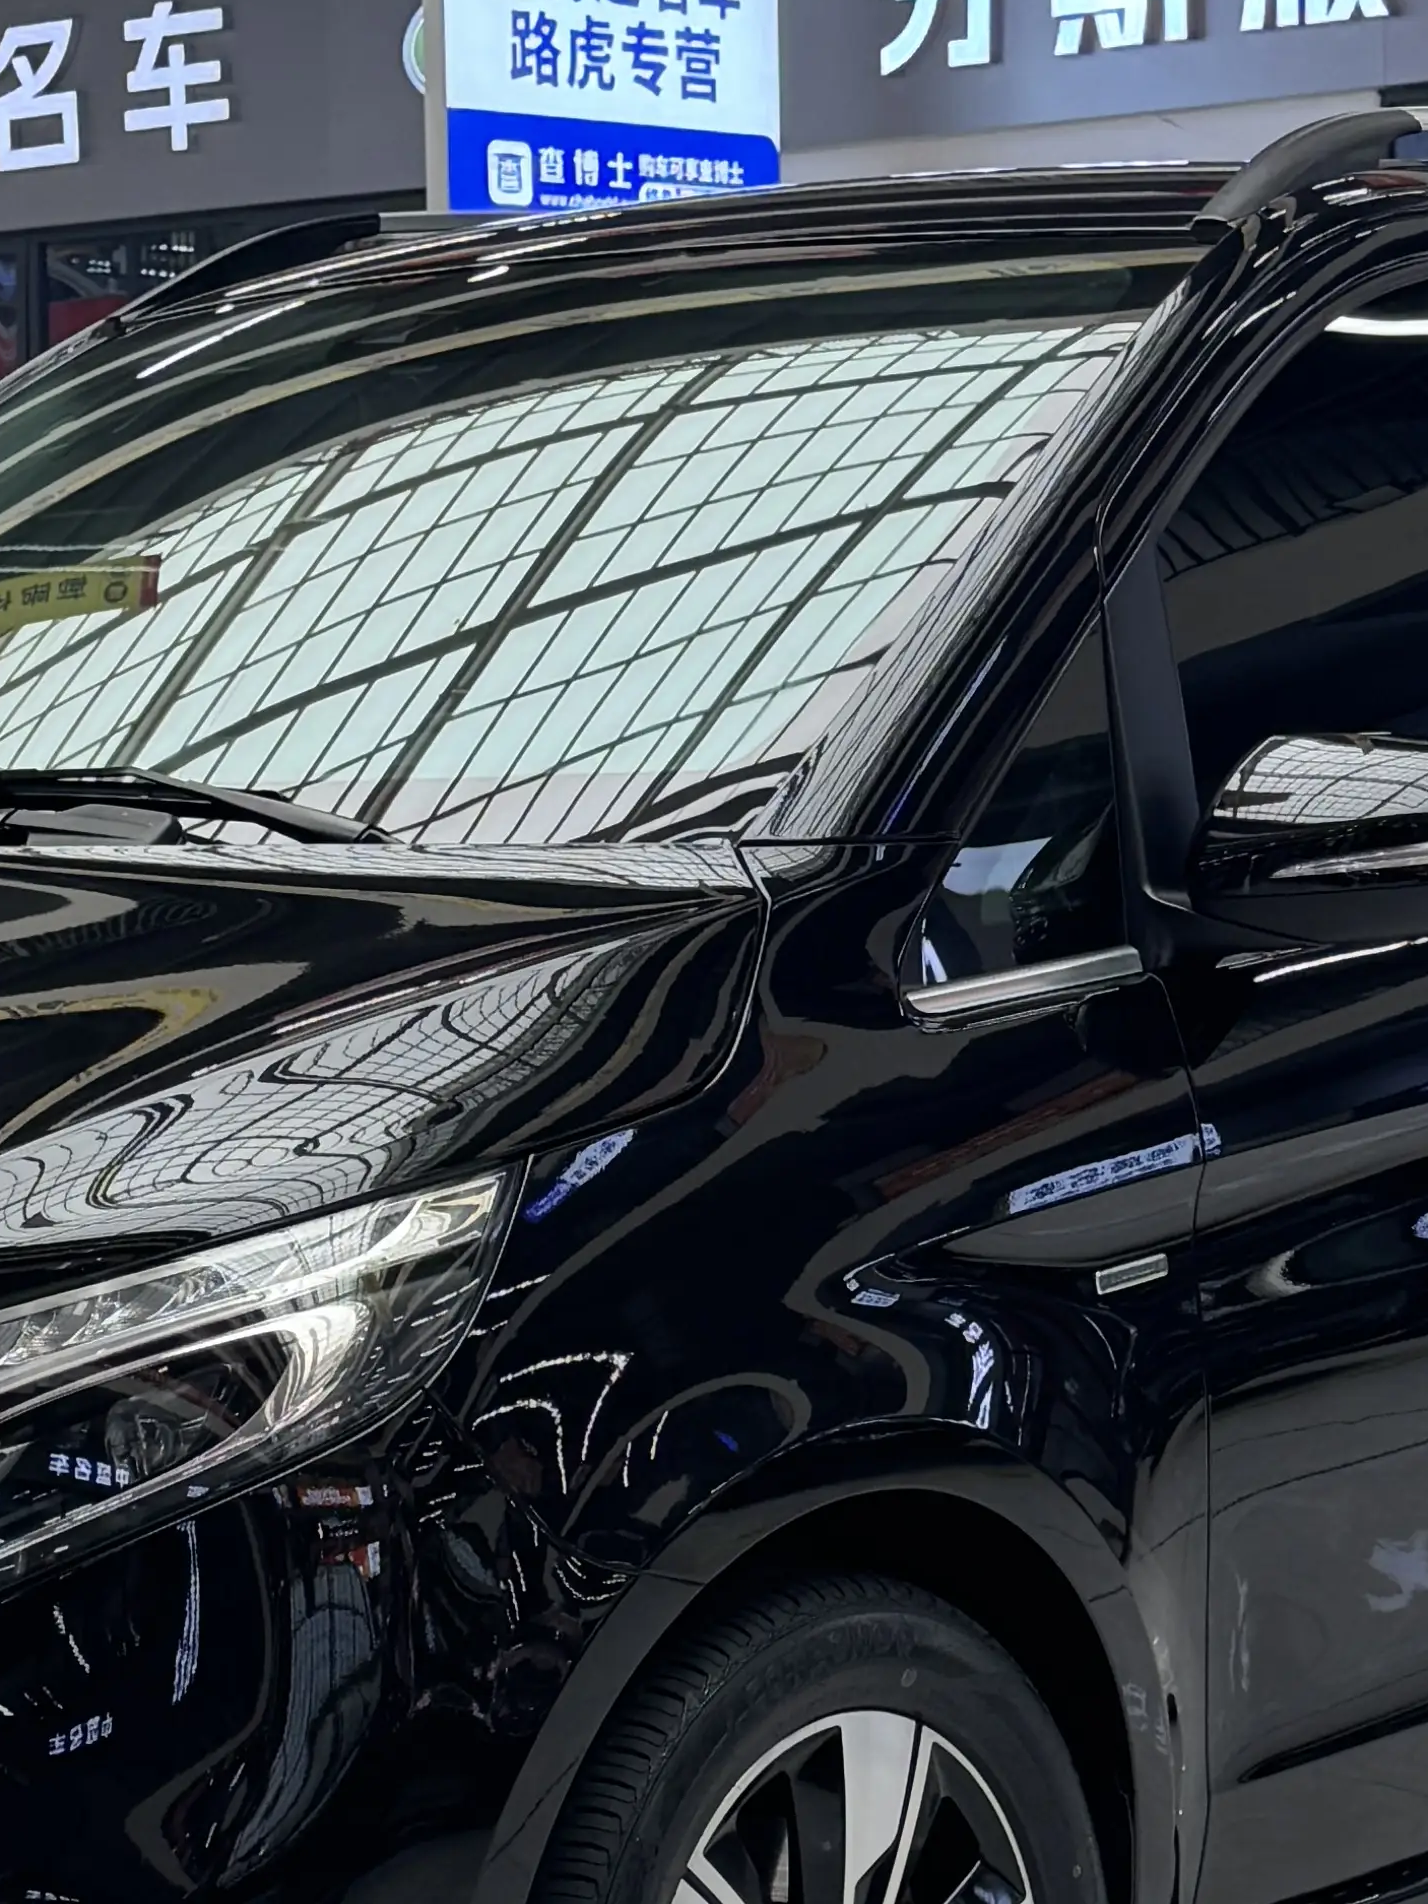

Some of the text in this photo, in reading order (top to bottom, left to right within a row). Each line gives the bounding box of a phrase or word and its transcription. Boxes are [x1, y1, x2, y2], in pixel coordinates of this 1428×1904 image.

[509, 8, 722, 104] 路虎专营
[538, 146, 634, 190] 查博士
